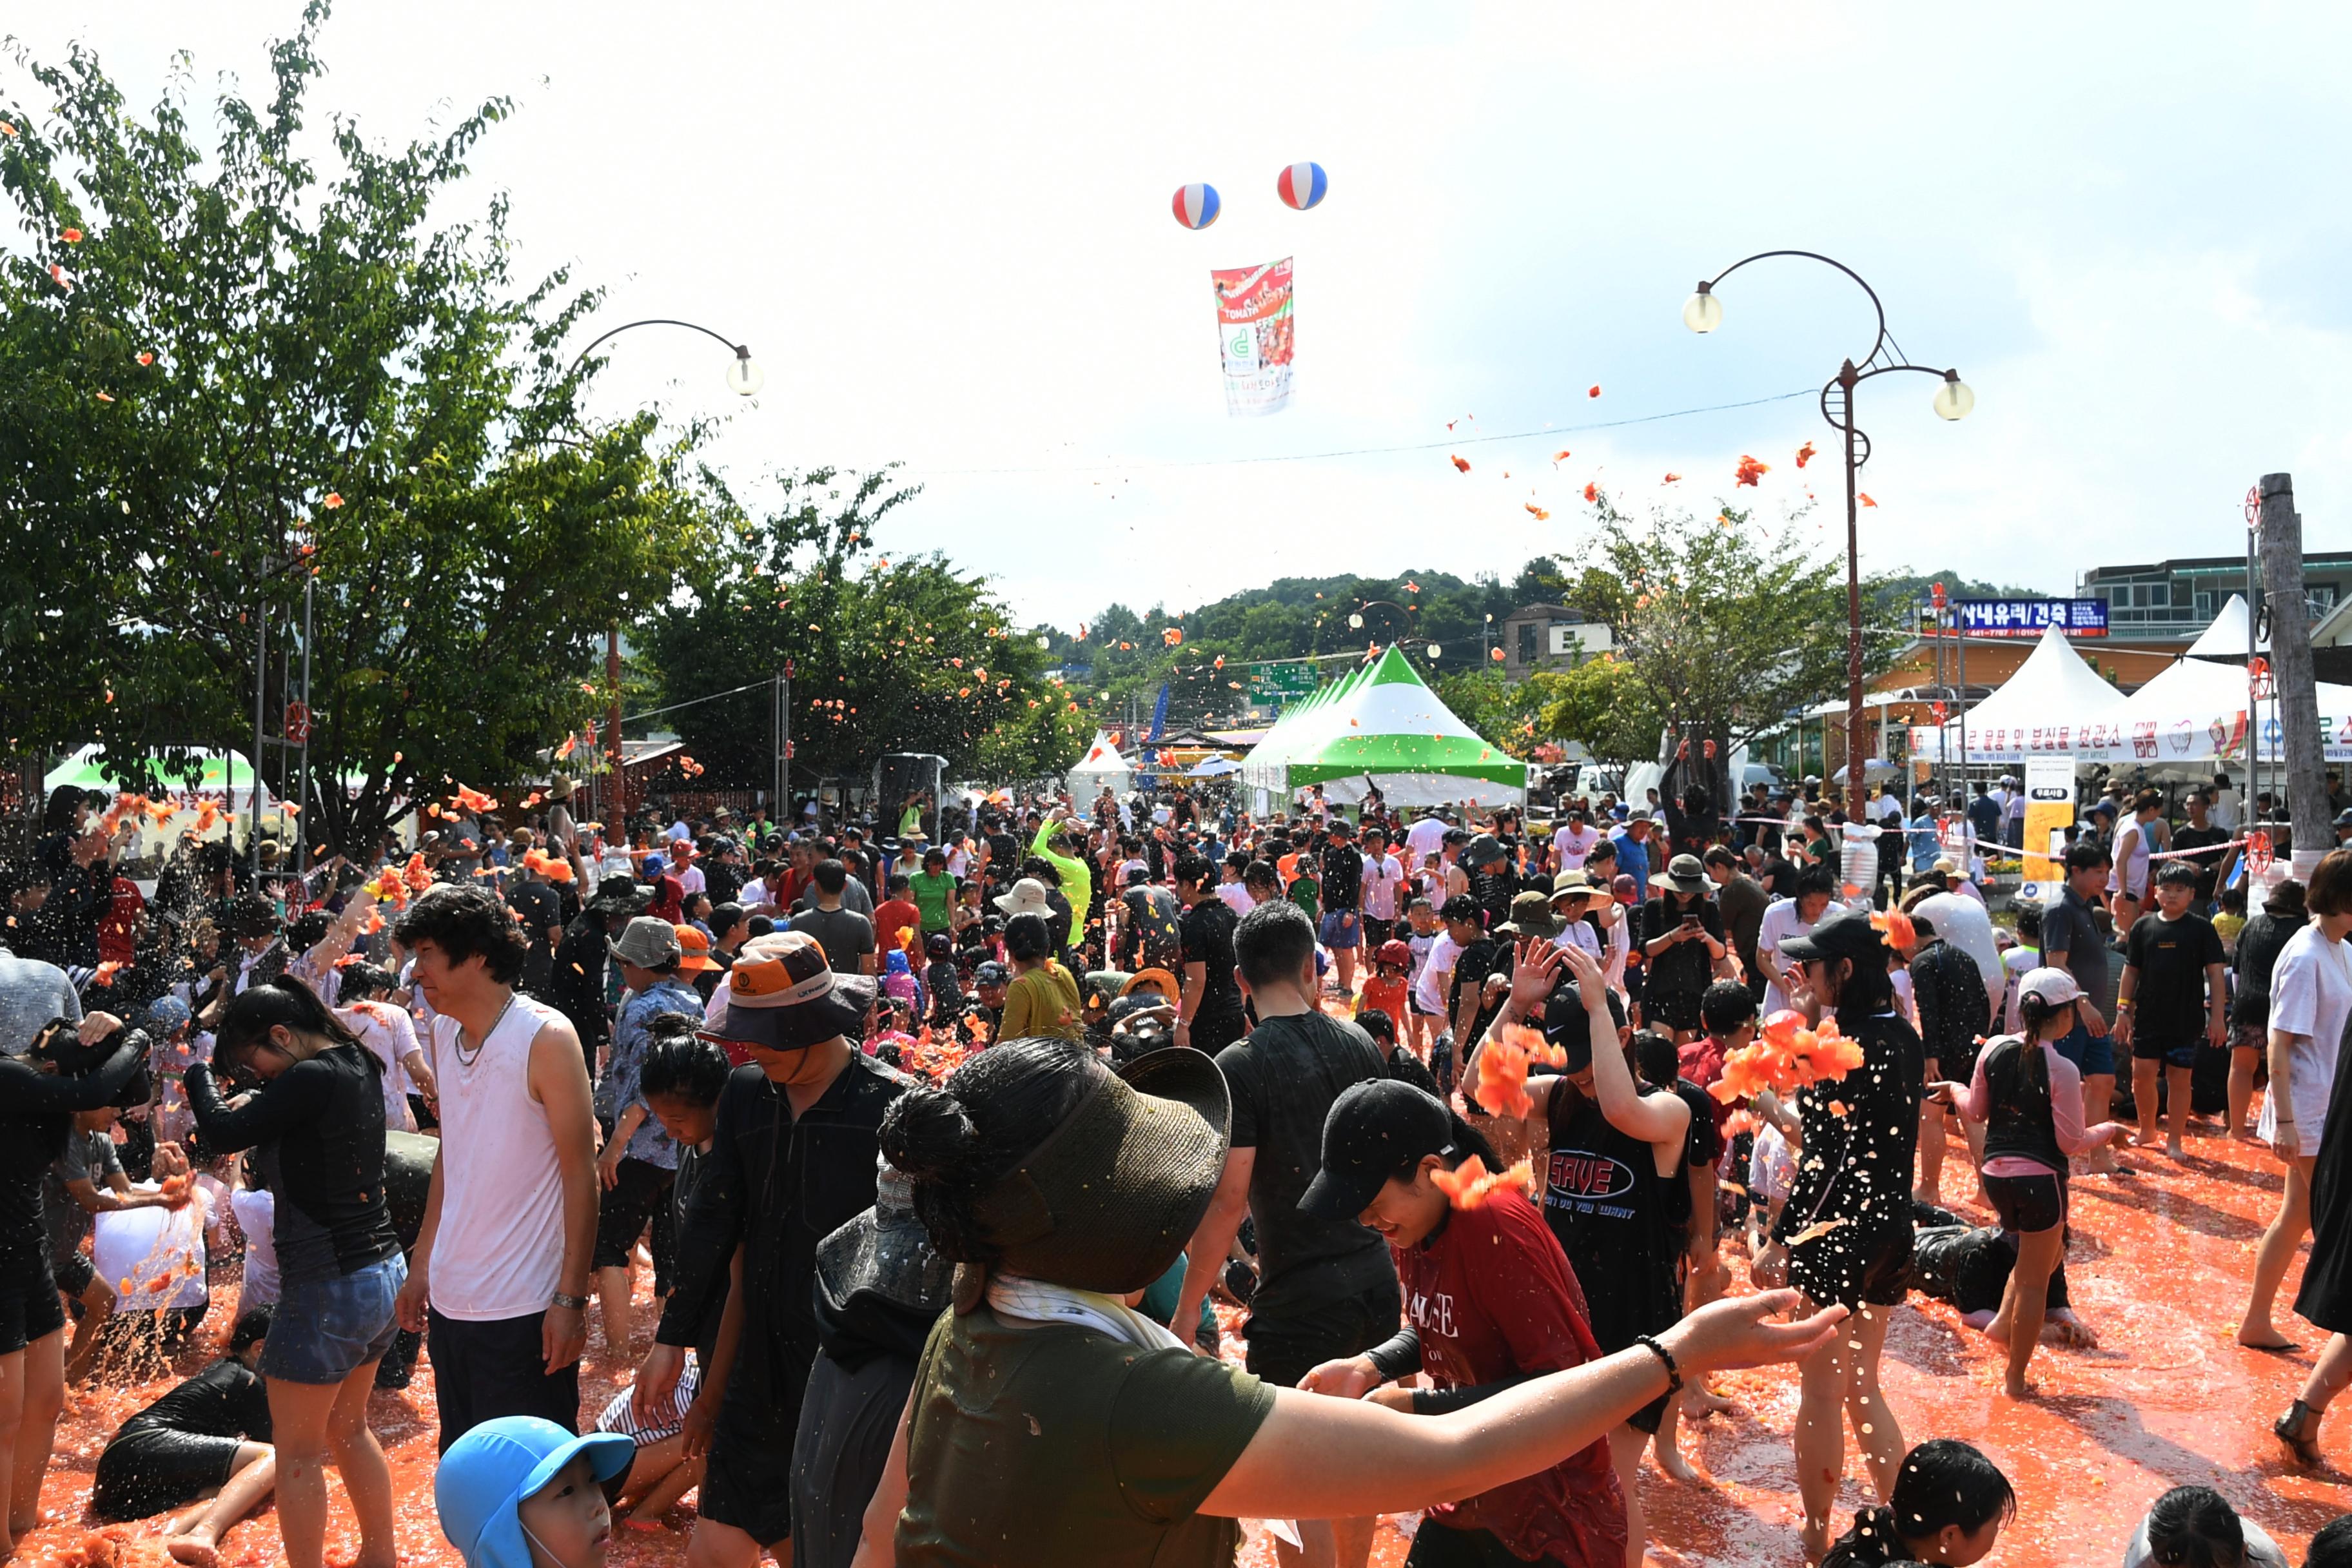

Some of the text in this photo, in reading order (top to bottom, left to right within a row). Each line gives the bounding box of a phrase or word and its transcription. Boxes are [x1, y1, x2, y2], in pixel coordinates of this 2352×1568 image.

[1984, 729, 2006, 751] 물품
[2013, 729, 2023, 751] 및
[2031, 727, 2070, 750] 분실물
[2079, 724, 2121, 749] 보관소
[1549, 1154, 1614, 1196] SAVE
[1576, 1200, 1594, 1214] YOU
[1598, 1204, 1636, 1220] WANT
